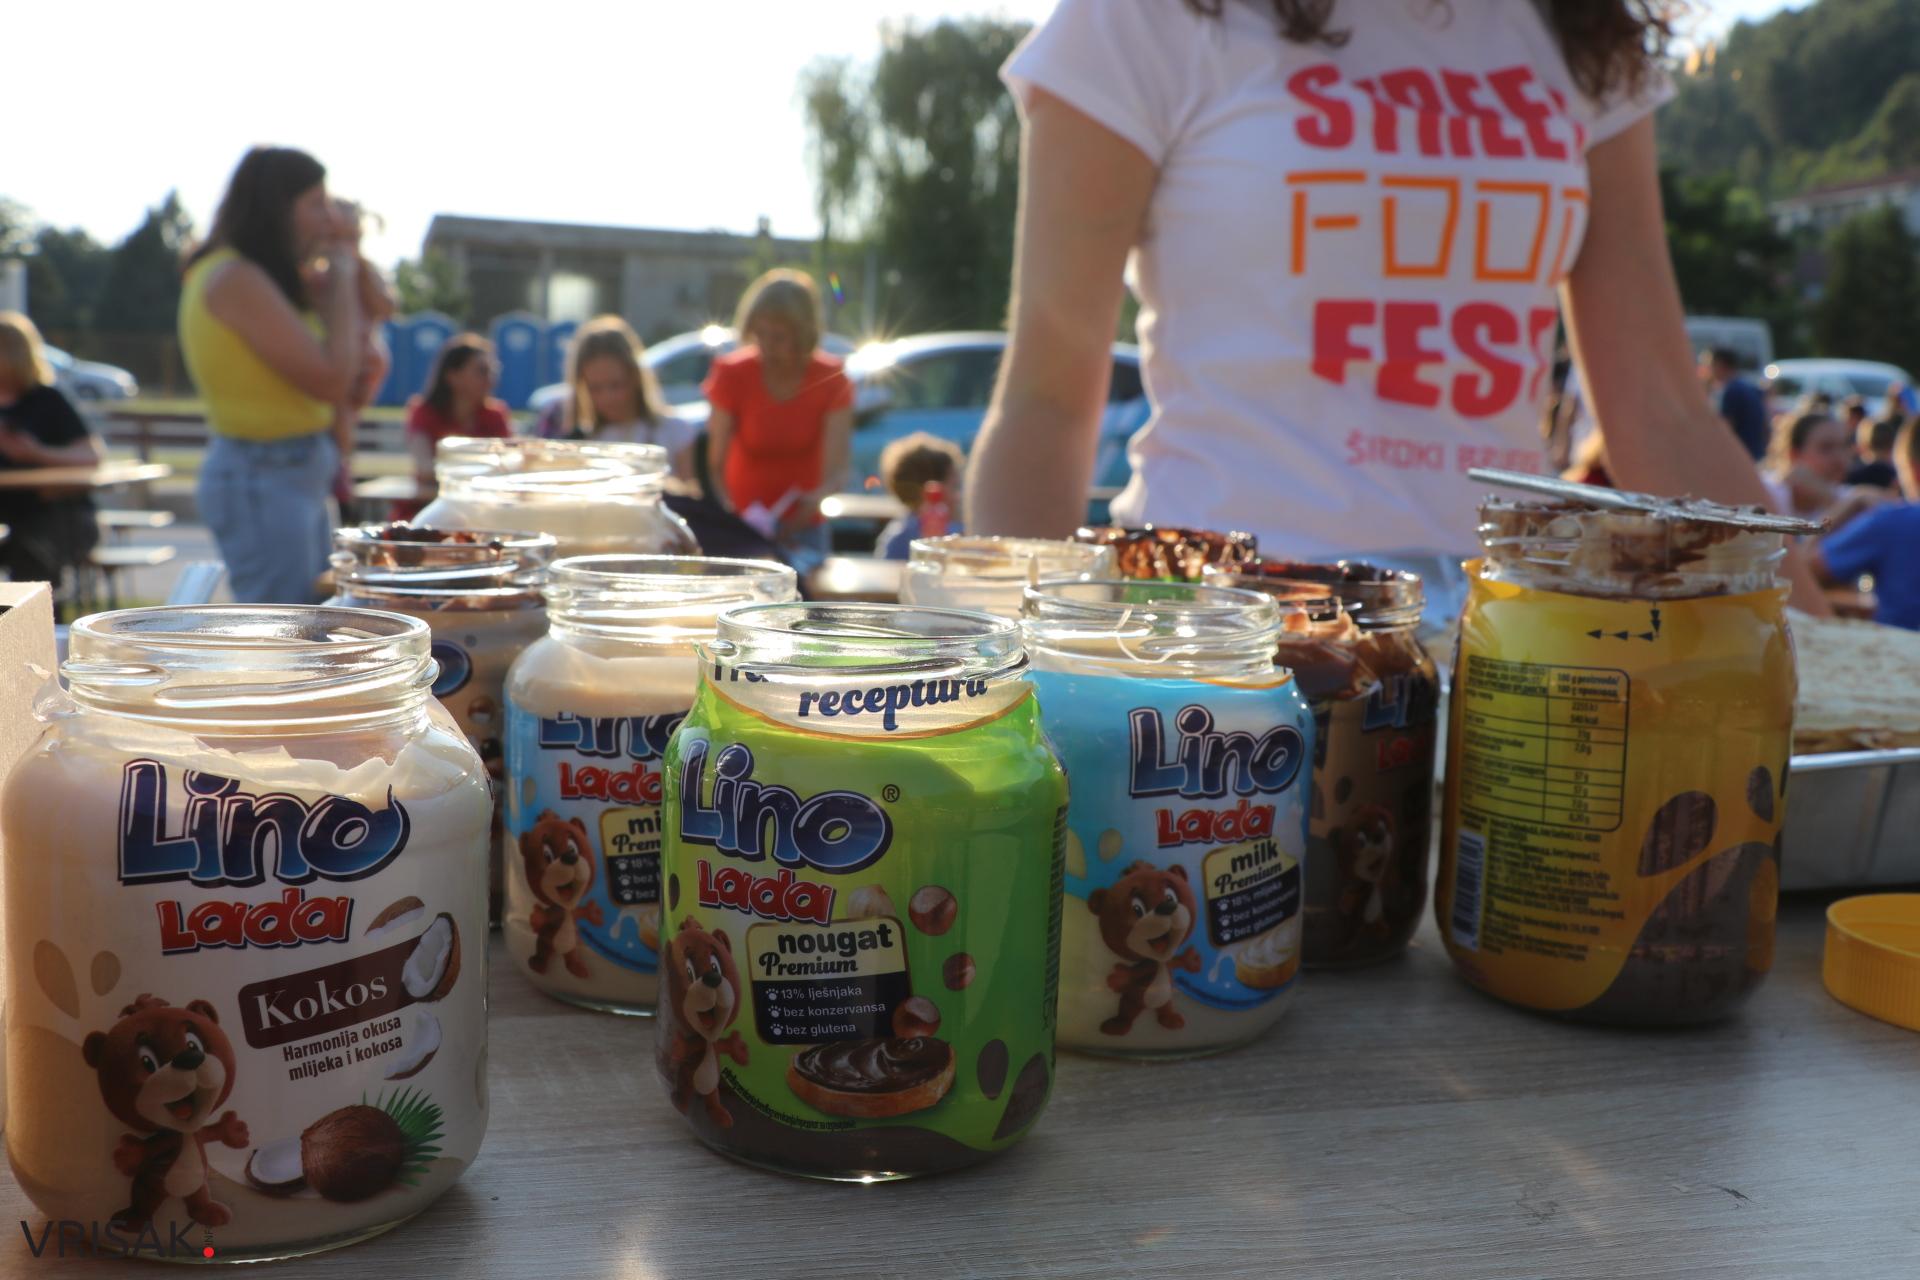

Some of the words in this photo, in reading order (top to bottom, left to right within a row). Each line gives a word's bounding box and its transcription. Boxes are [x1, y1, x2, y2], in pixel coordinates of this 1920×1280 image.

[1128, 704, 1304, 799] Lino
[117, 758, 411, 888] Lino
[628, 810, 661, 835] mi
[680, 739, 893, 875] Lino
[1156, 797, 1276, 848] Lada
[1215, 863, 1282, 894] Premium
[1231, 840, 1278, 873] milk
[697, 860, 837, 927] Lada
[156, 887, 354, 955] Lada
[778, 923, 893, 957] nougat
[759, 952, 858, 976] Premium
[254, 976, 388, 1031] Kokos
[782, 987, 805, 999] 13%
[808, 985, 862, 1000] lješnjaka
[783, 1006, 805, 1017] bez
[808, 1003, 886, 1017] konzervansa
[283, 1030, 358, 1062] Harmonija
[363, 1017, 402, 1039] okusa
[786, 1024, 807, 1035] bez
[810, 1023, 856, 1036] glutena
[289, 1055, 343, 1081] mlijeka
[346, 1051, 352, 1065] i
[356, 1036, 403, 1063] kokosa
